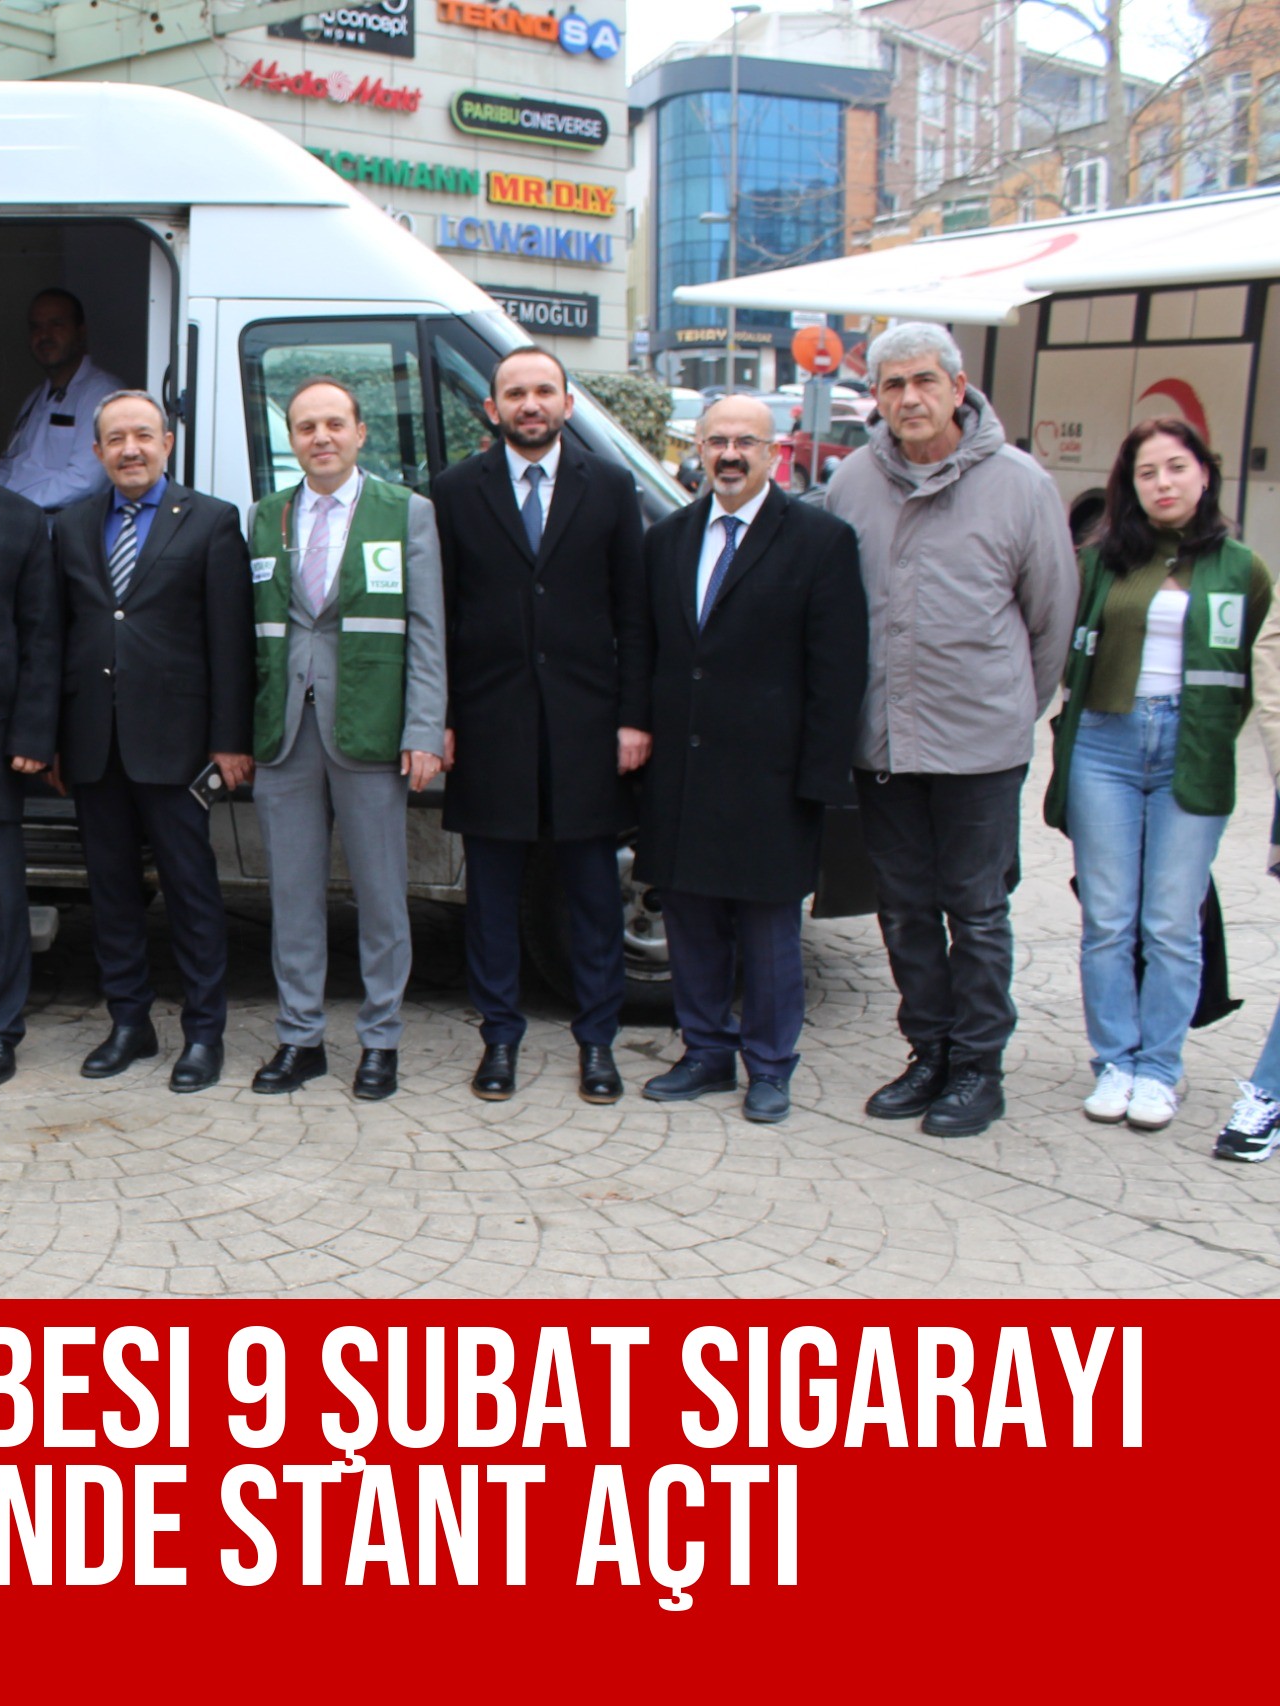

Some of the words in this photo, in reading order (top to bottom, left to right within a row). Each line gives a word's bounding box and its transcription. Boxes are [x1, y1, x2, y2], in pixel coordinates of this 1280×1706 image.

[323, 27, 366, 44] HOME
[337, 8, 408, 38] concept
[436, 0, 619, 54] TEKNOSA
[305, 146, 480, 195] ICHMANN
